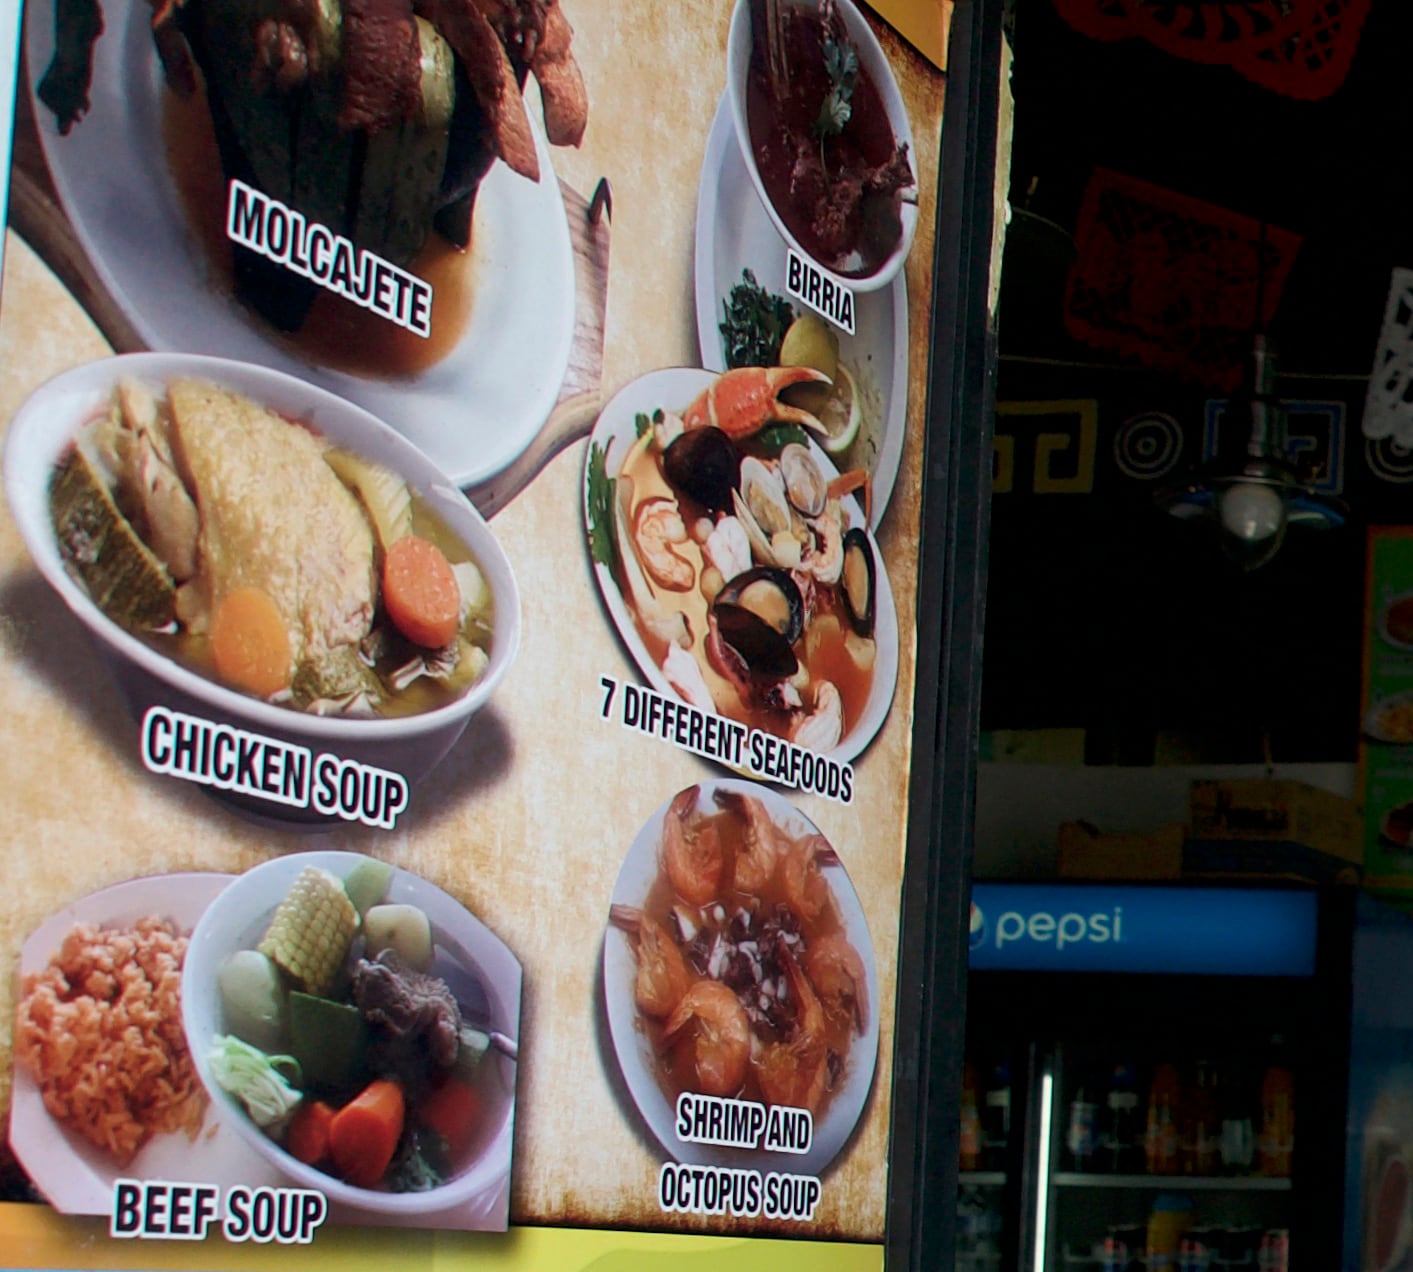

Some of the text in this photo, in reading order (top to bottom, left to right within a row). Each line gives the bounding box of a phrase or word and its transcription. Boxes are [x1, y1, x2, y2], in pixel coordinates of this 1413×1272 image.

[230, 184, 432, 334] MOLCAJETE
[786, 252, 855, 330] BIRRIA
[146, 715, 406, 823] CHICKEN SOUP
[601, 679, 854, 800] 7 DIFFERENT SEAFOODS
[995, 906, 1124, 951] pepsi
[678, 1096, 811, 1150] SHRIMP AND
[113, 1185, 326, 1243] BEEF SOUP
[660, 1167, 819, 1216] OCTOPUS SOUP
